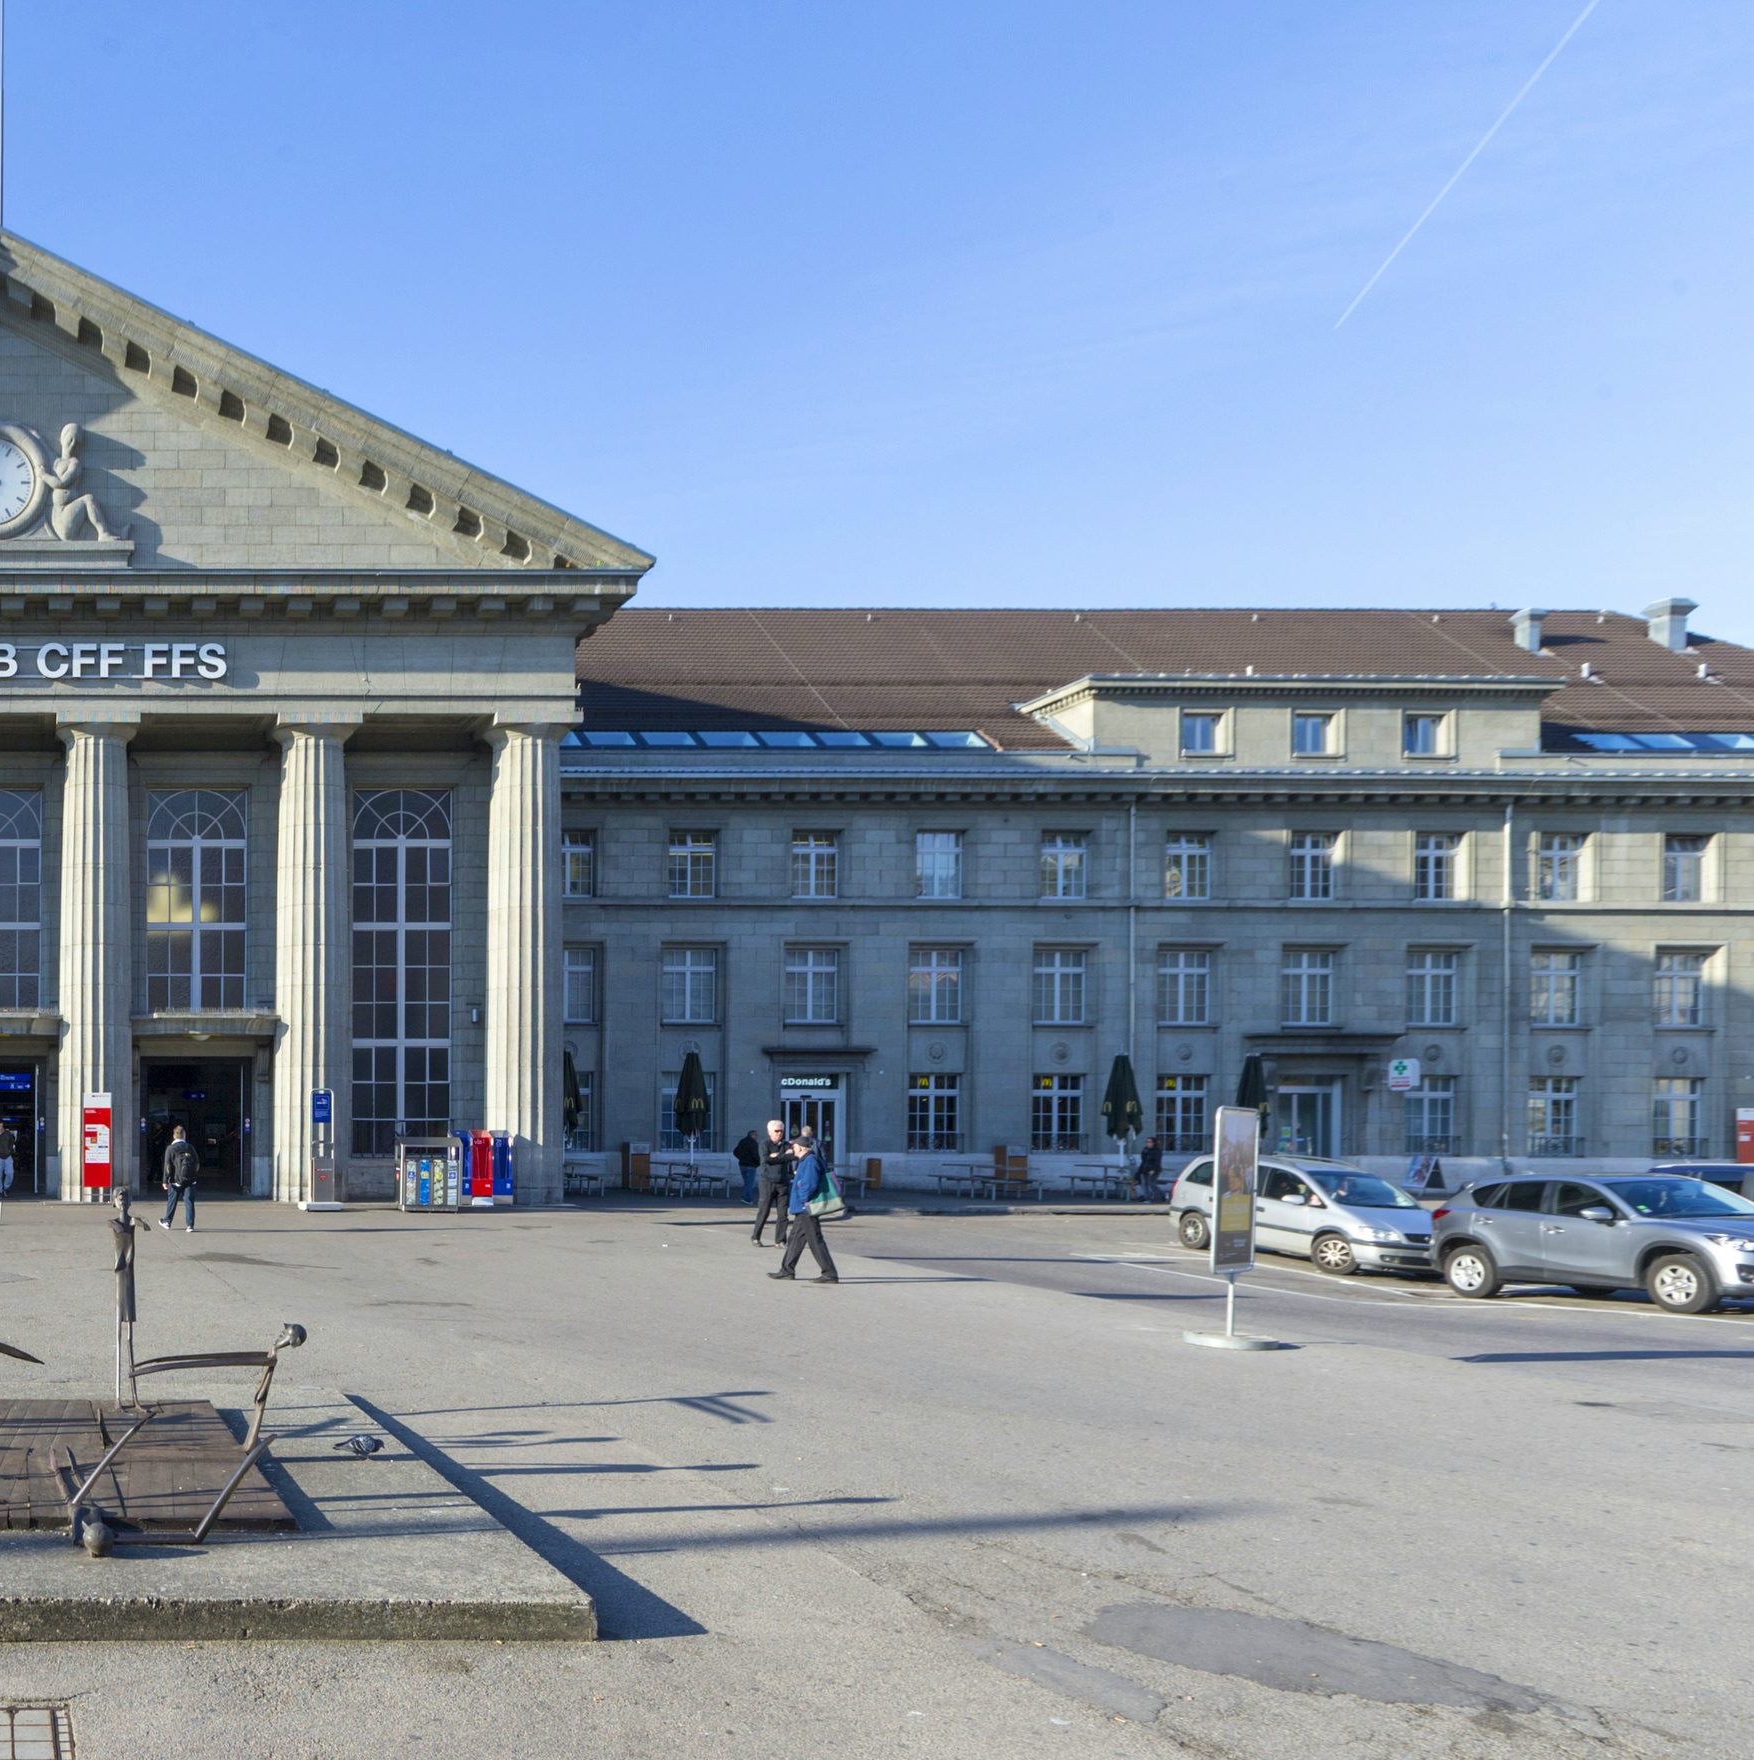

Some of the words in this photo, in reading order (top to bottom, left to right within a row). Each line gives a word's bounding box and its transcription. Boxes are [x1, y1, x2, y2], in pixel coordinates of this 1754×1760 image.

[36, 642, 125, 679] CFF
[143, 642, 227, 679] FFS
[781, 1077, 832, 1086] cDonald's
